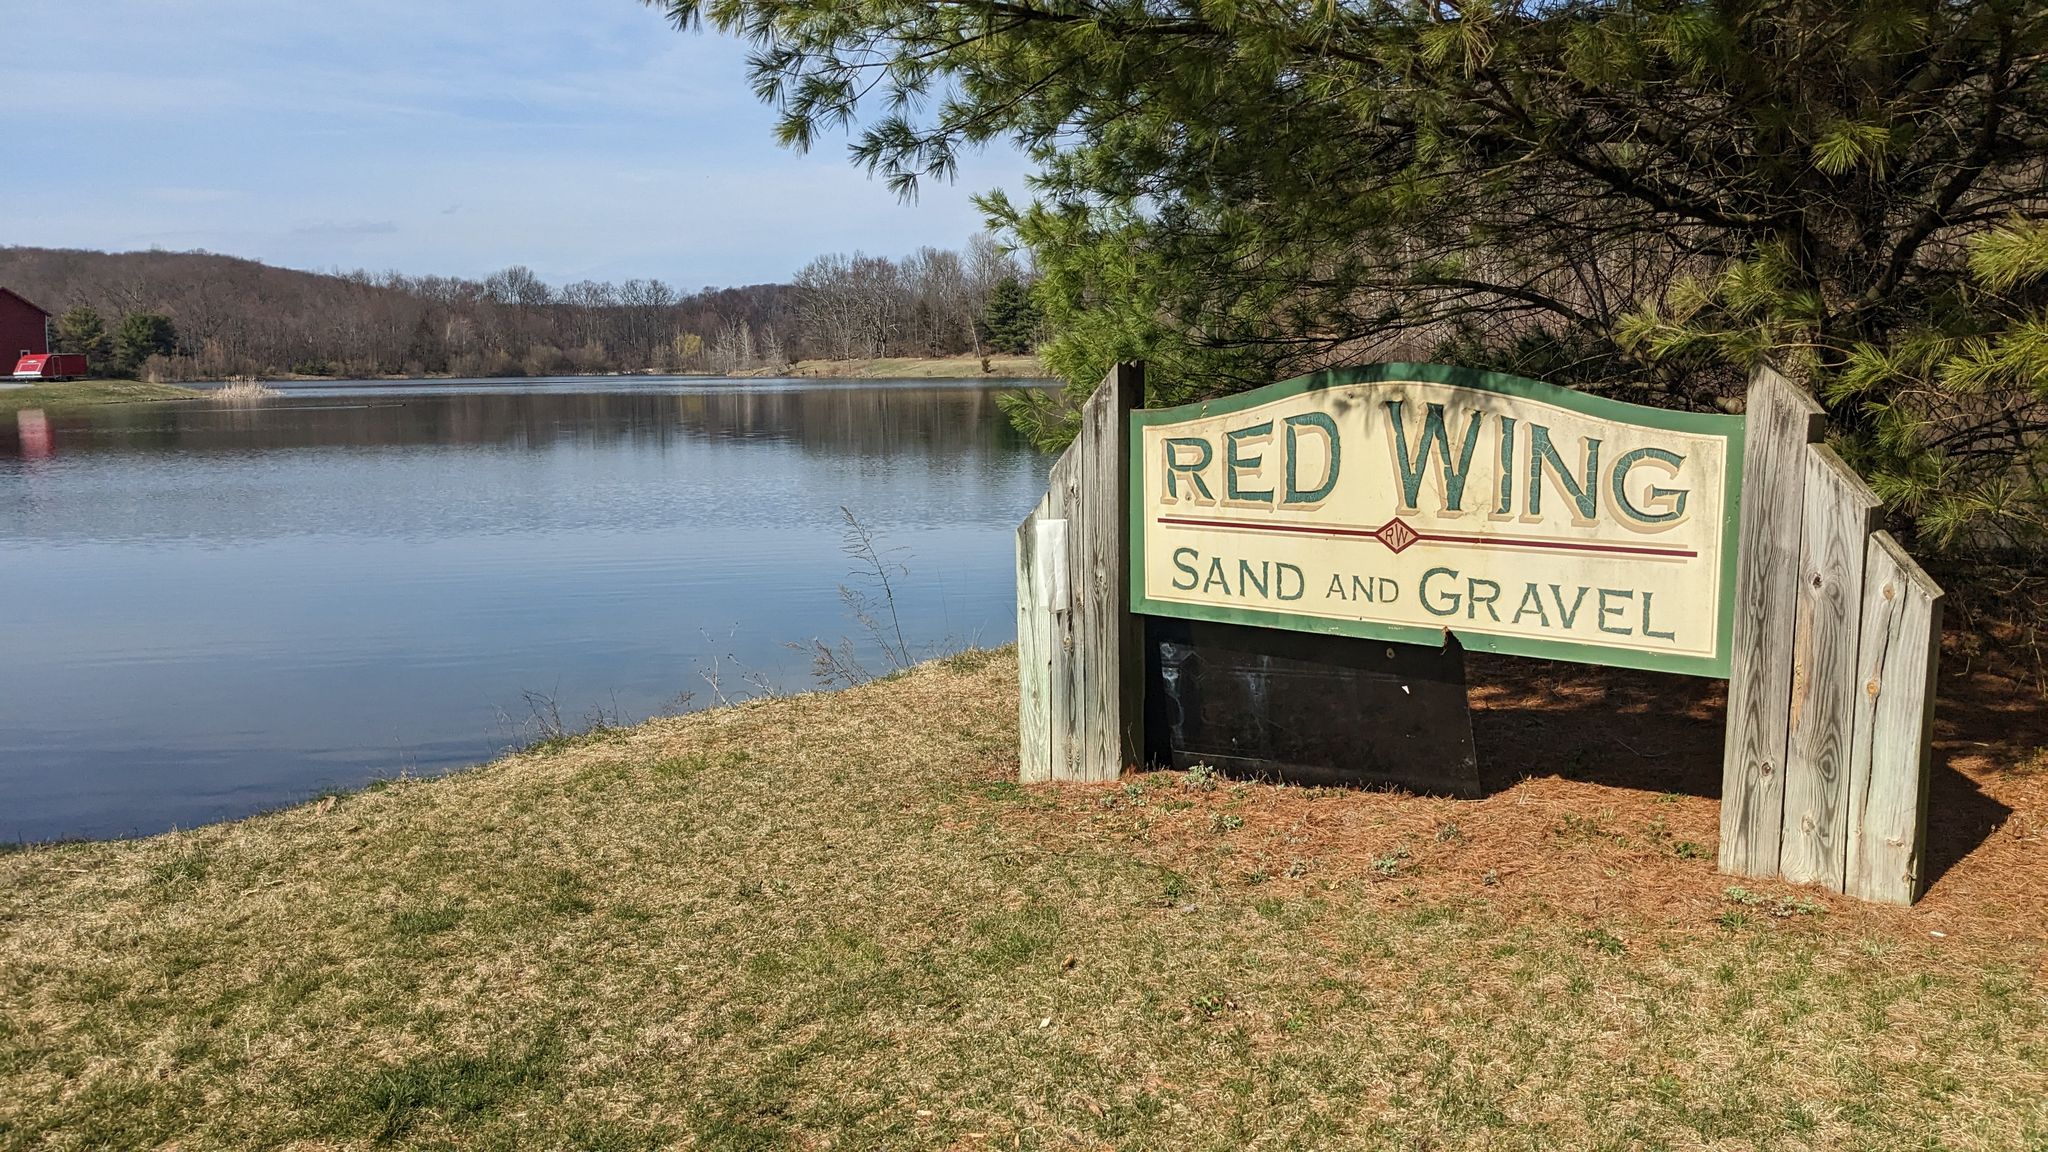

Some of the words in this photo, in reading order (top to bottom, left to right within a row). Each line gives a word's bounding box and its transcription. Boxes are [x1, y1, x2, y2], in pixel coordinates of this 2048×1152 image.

[1162, 410, 1341, 510] RED
[1382, 399, 1688, 530] WING
[1385, 523, 1408, 547] RW
[1172, 546, 1305, 601] SAND
[1325, 573, 1399, 603] AND
[1418, 566, 1676, 641] GRAVEL
